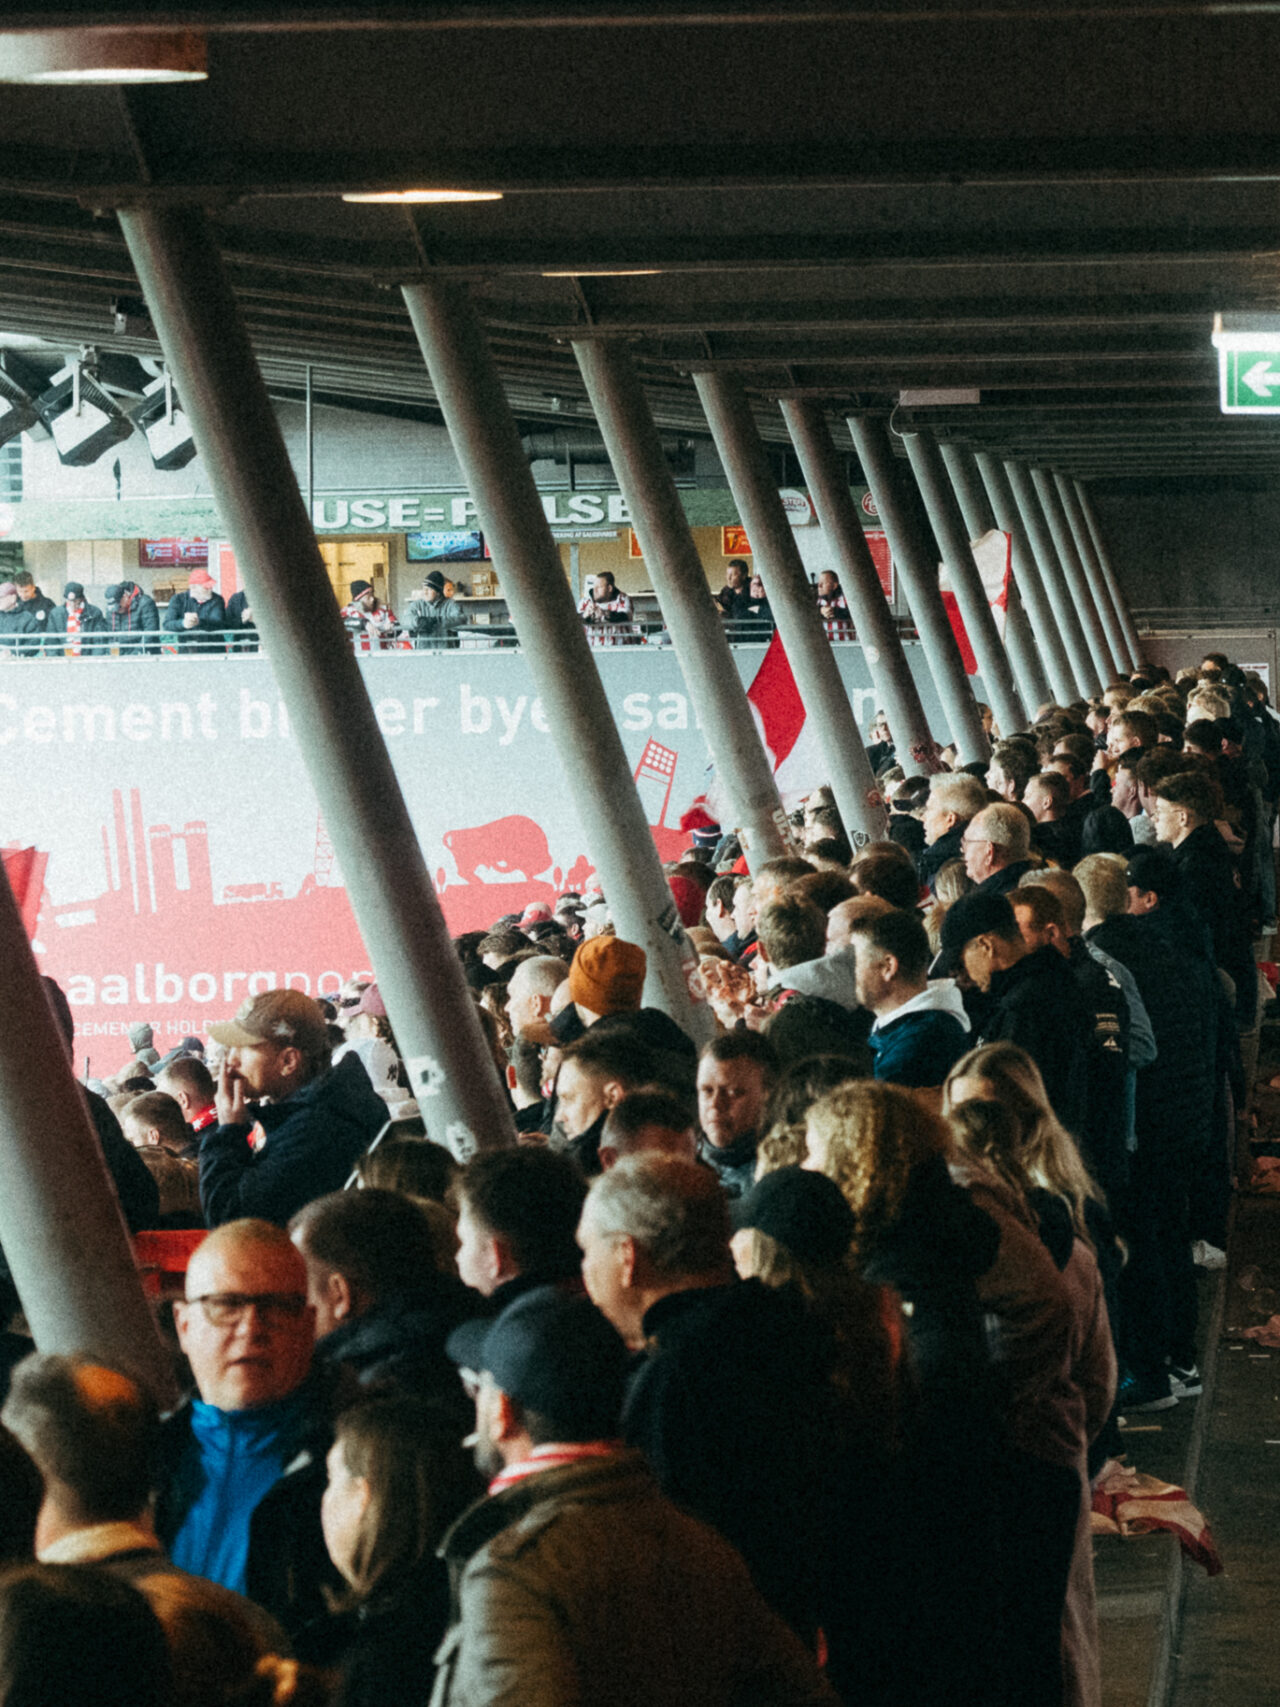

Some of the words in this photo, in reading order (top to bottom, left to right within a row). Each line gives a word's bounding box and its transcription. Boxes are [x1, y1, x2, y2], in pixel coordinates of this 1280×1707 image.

[459, 683, 552, 747] bye
[67, 962, 373, 1006] aalborgpor
[73, 1020, 162, 1037] CEMENR
[166, 1018, 228, 1036] HOLD
